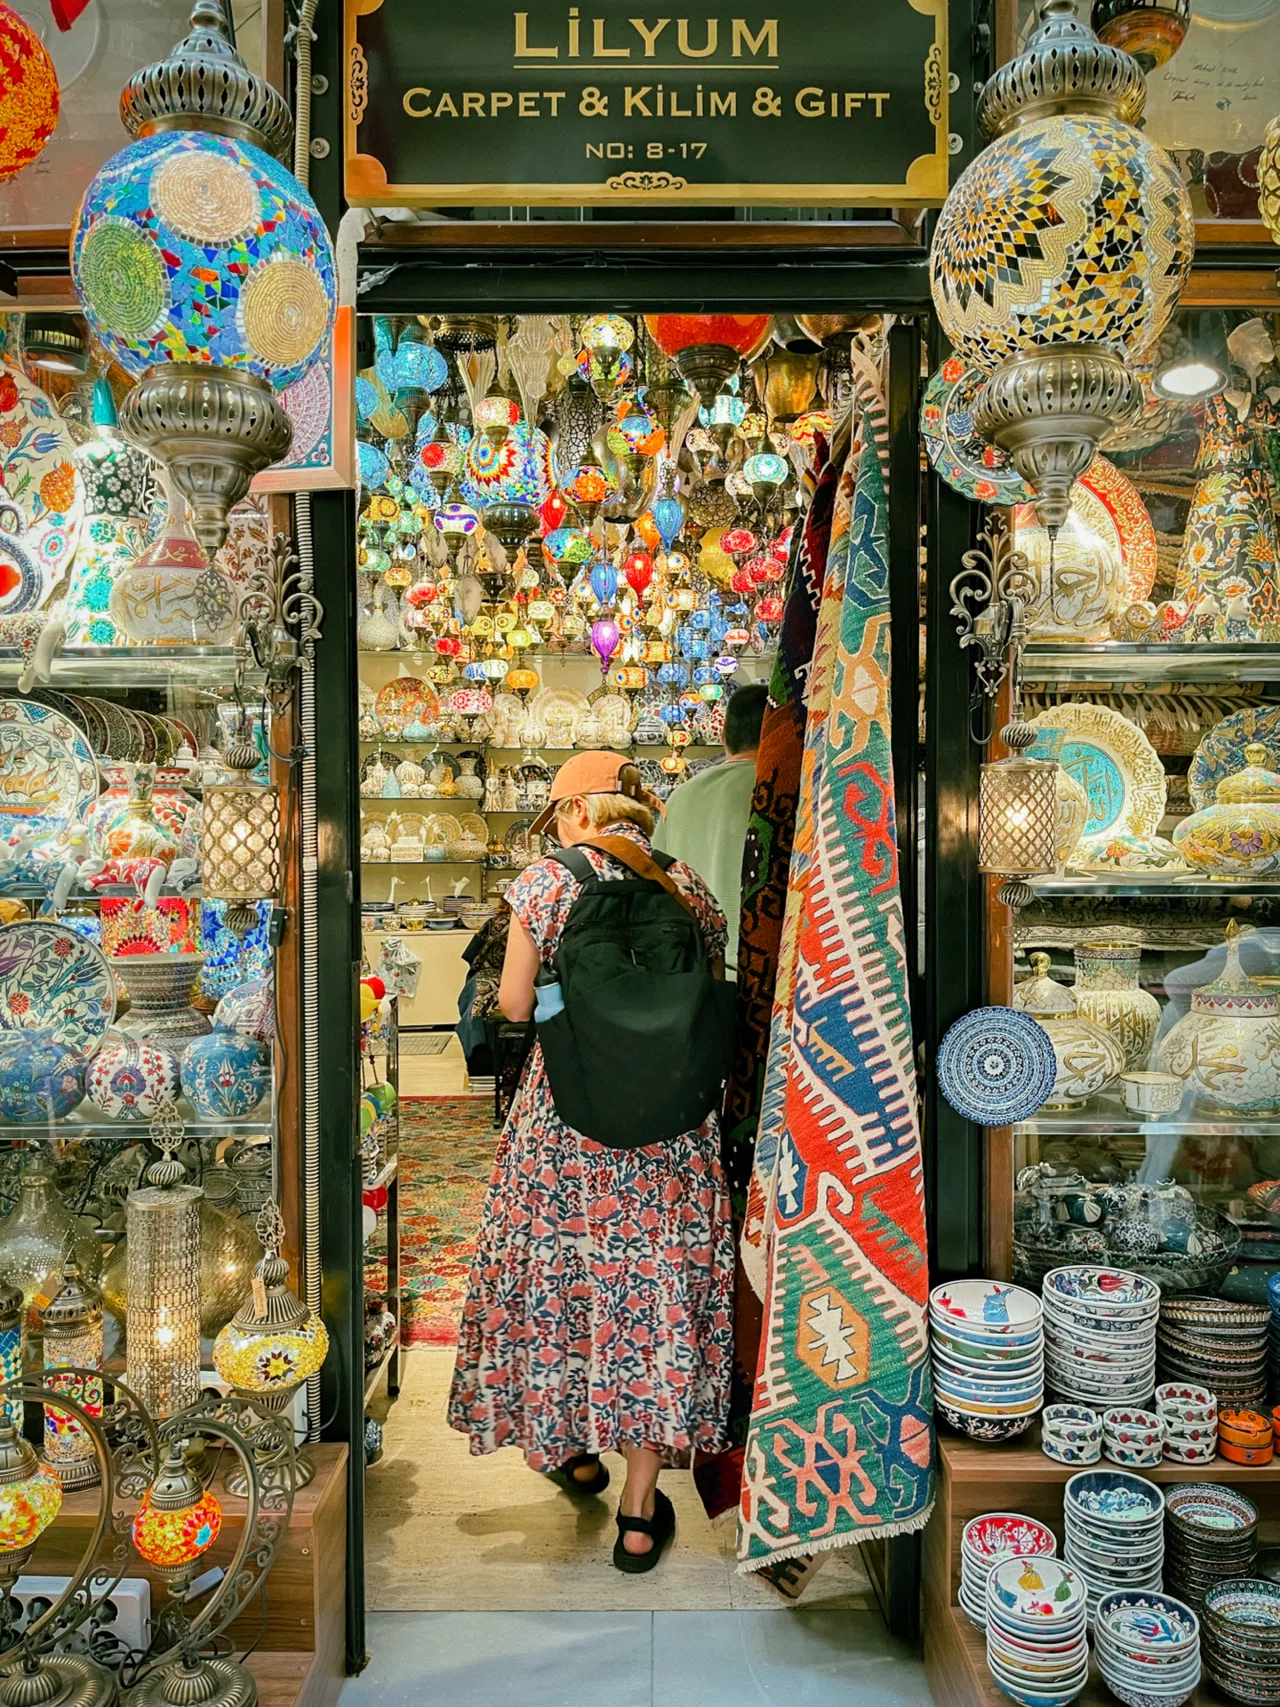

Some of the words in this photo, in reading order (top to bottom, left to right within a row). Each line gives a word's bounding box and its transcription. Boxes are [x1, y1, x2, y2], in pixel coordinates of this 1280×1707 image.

[514, 7, 779, 58] LİLYUM
[402, 87, 566, 118] CARPET
[579, 86, 609, 117] &
[625, 84, 737, 117] KİLİM
[752, 86, 782, 117] &
[796, 86, 890, 118] GIFT
[585, 143, 633, 159] NO:
[647, 143, 708, 159] 8-17
